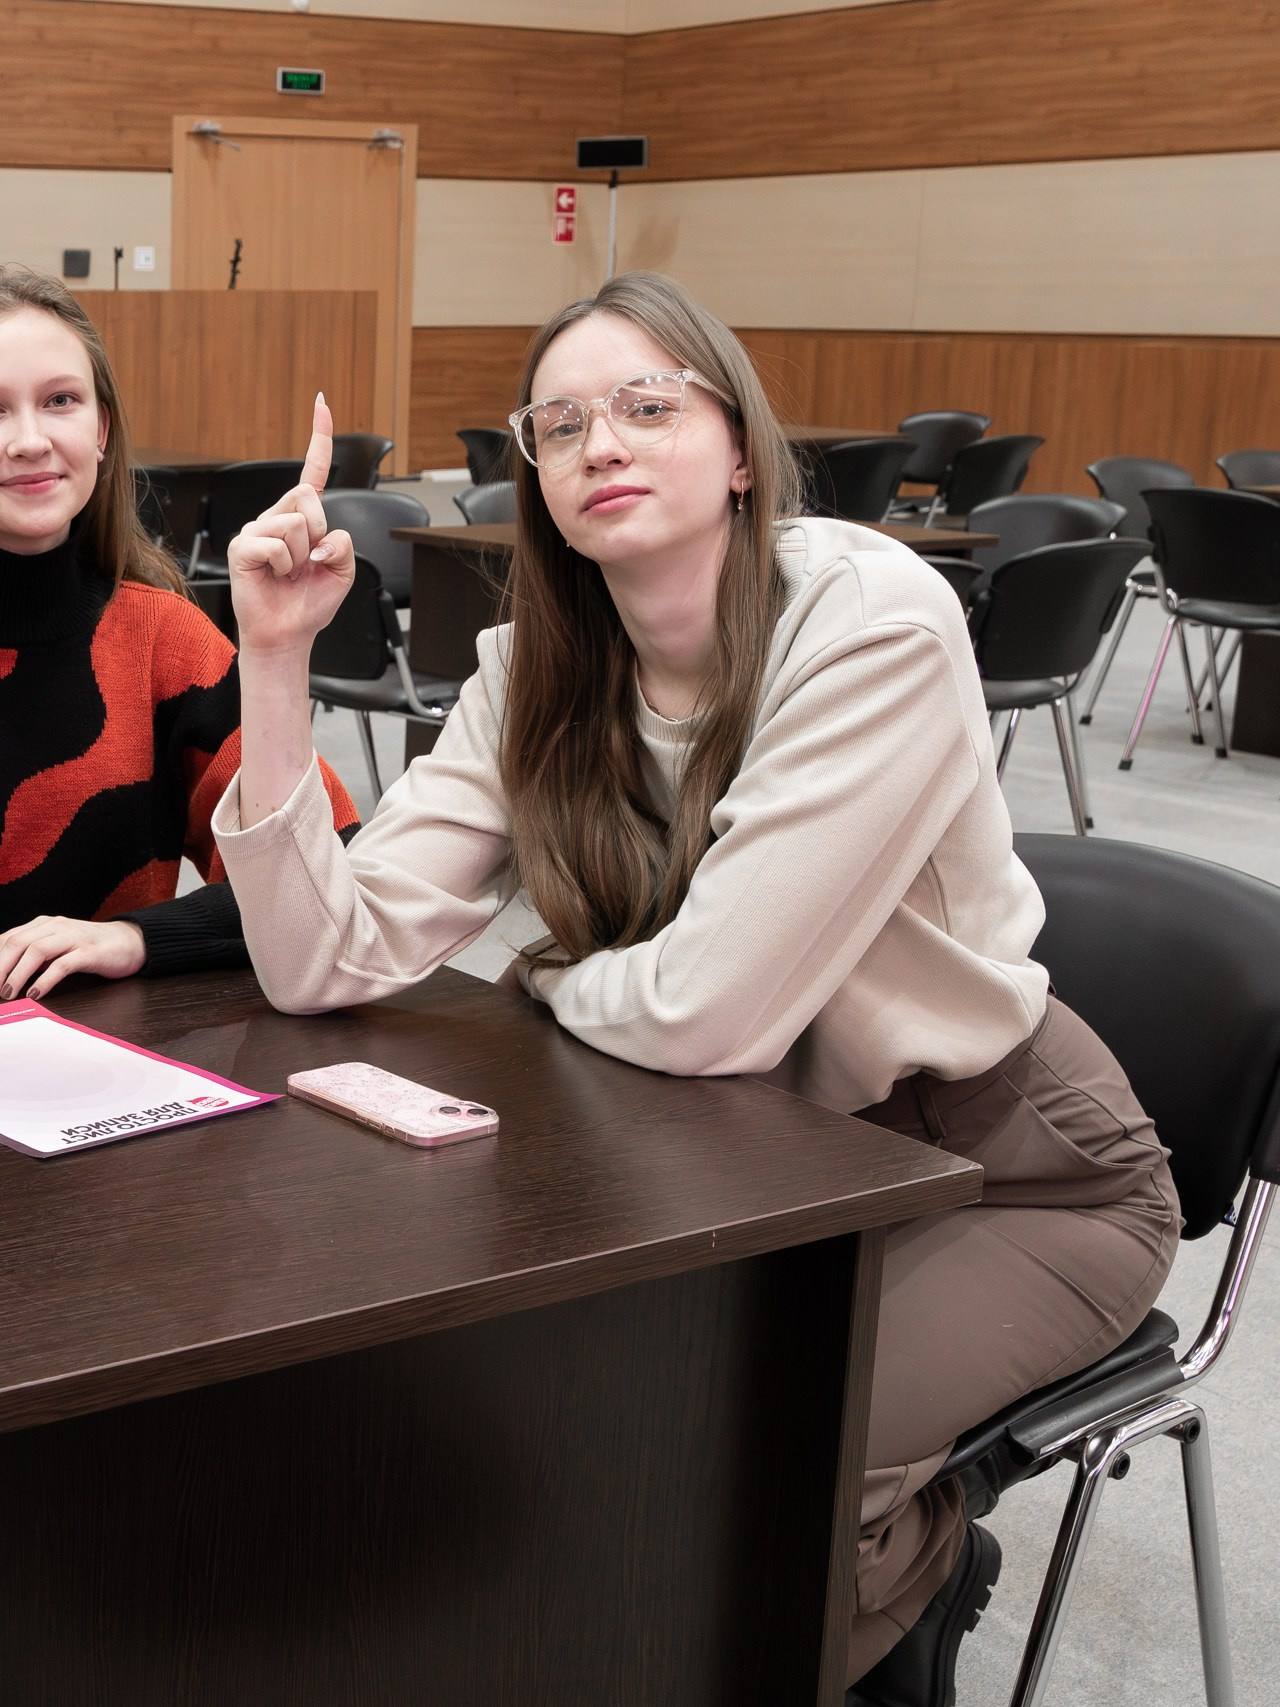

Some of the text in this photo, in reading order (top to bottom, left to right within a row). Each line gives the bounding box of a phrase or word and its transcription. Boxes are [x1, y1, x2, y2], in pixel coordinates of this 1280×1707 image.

[143, 1101, 186, 1117] ДЛЯ
[60, 1113, 142, 1136] ЗАПИСИ
[61, 1107, 199, 1145] ПРОСТО ЛИСТ
